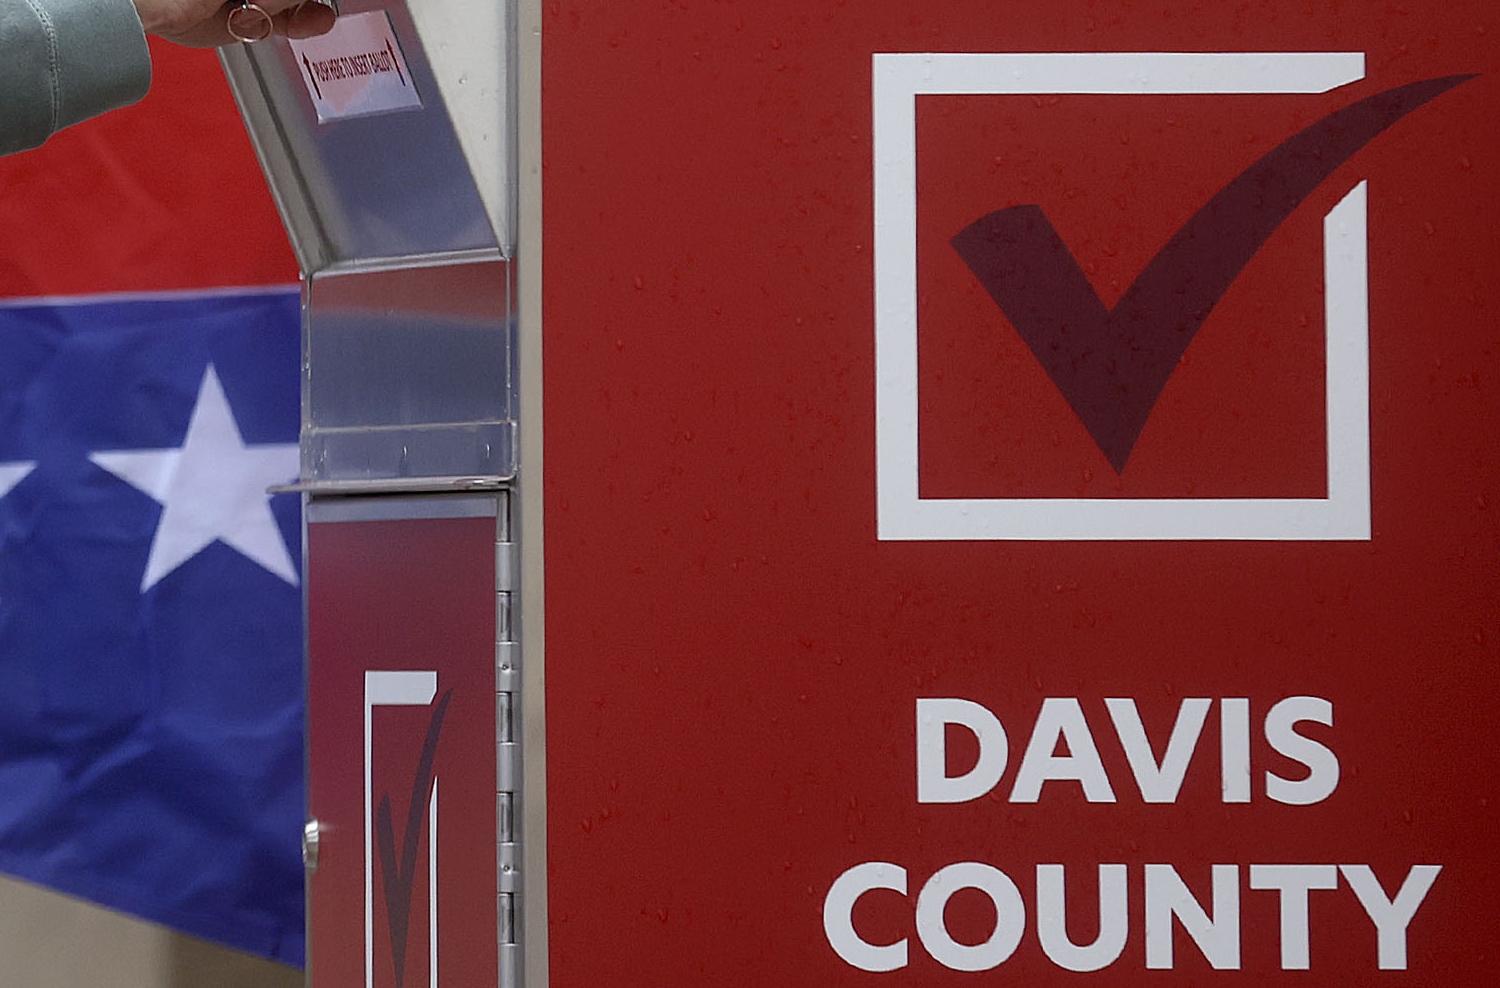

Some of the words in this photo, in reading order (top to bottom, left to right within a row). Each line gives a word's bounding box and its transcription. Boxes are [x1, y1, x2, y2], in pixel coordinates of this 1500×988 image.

[312, 61, 330, 82] PUSH
[326, 57, 346, 80] HERE
[349, 53, 371, 76] INSERT
[367, 50, 393, 73] BALLOT
[915, 696, 1341, 805] DAVIS
[823, 862, 1443, 972] COUNTY
